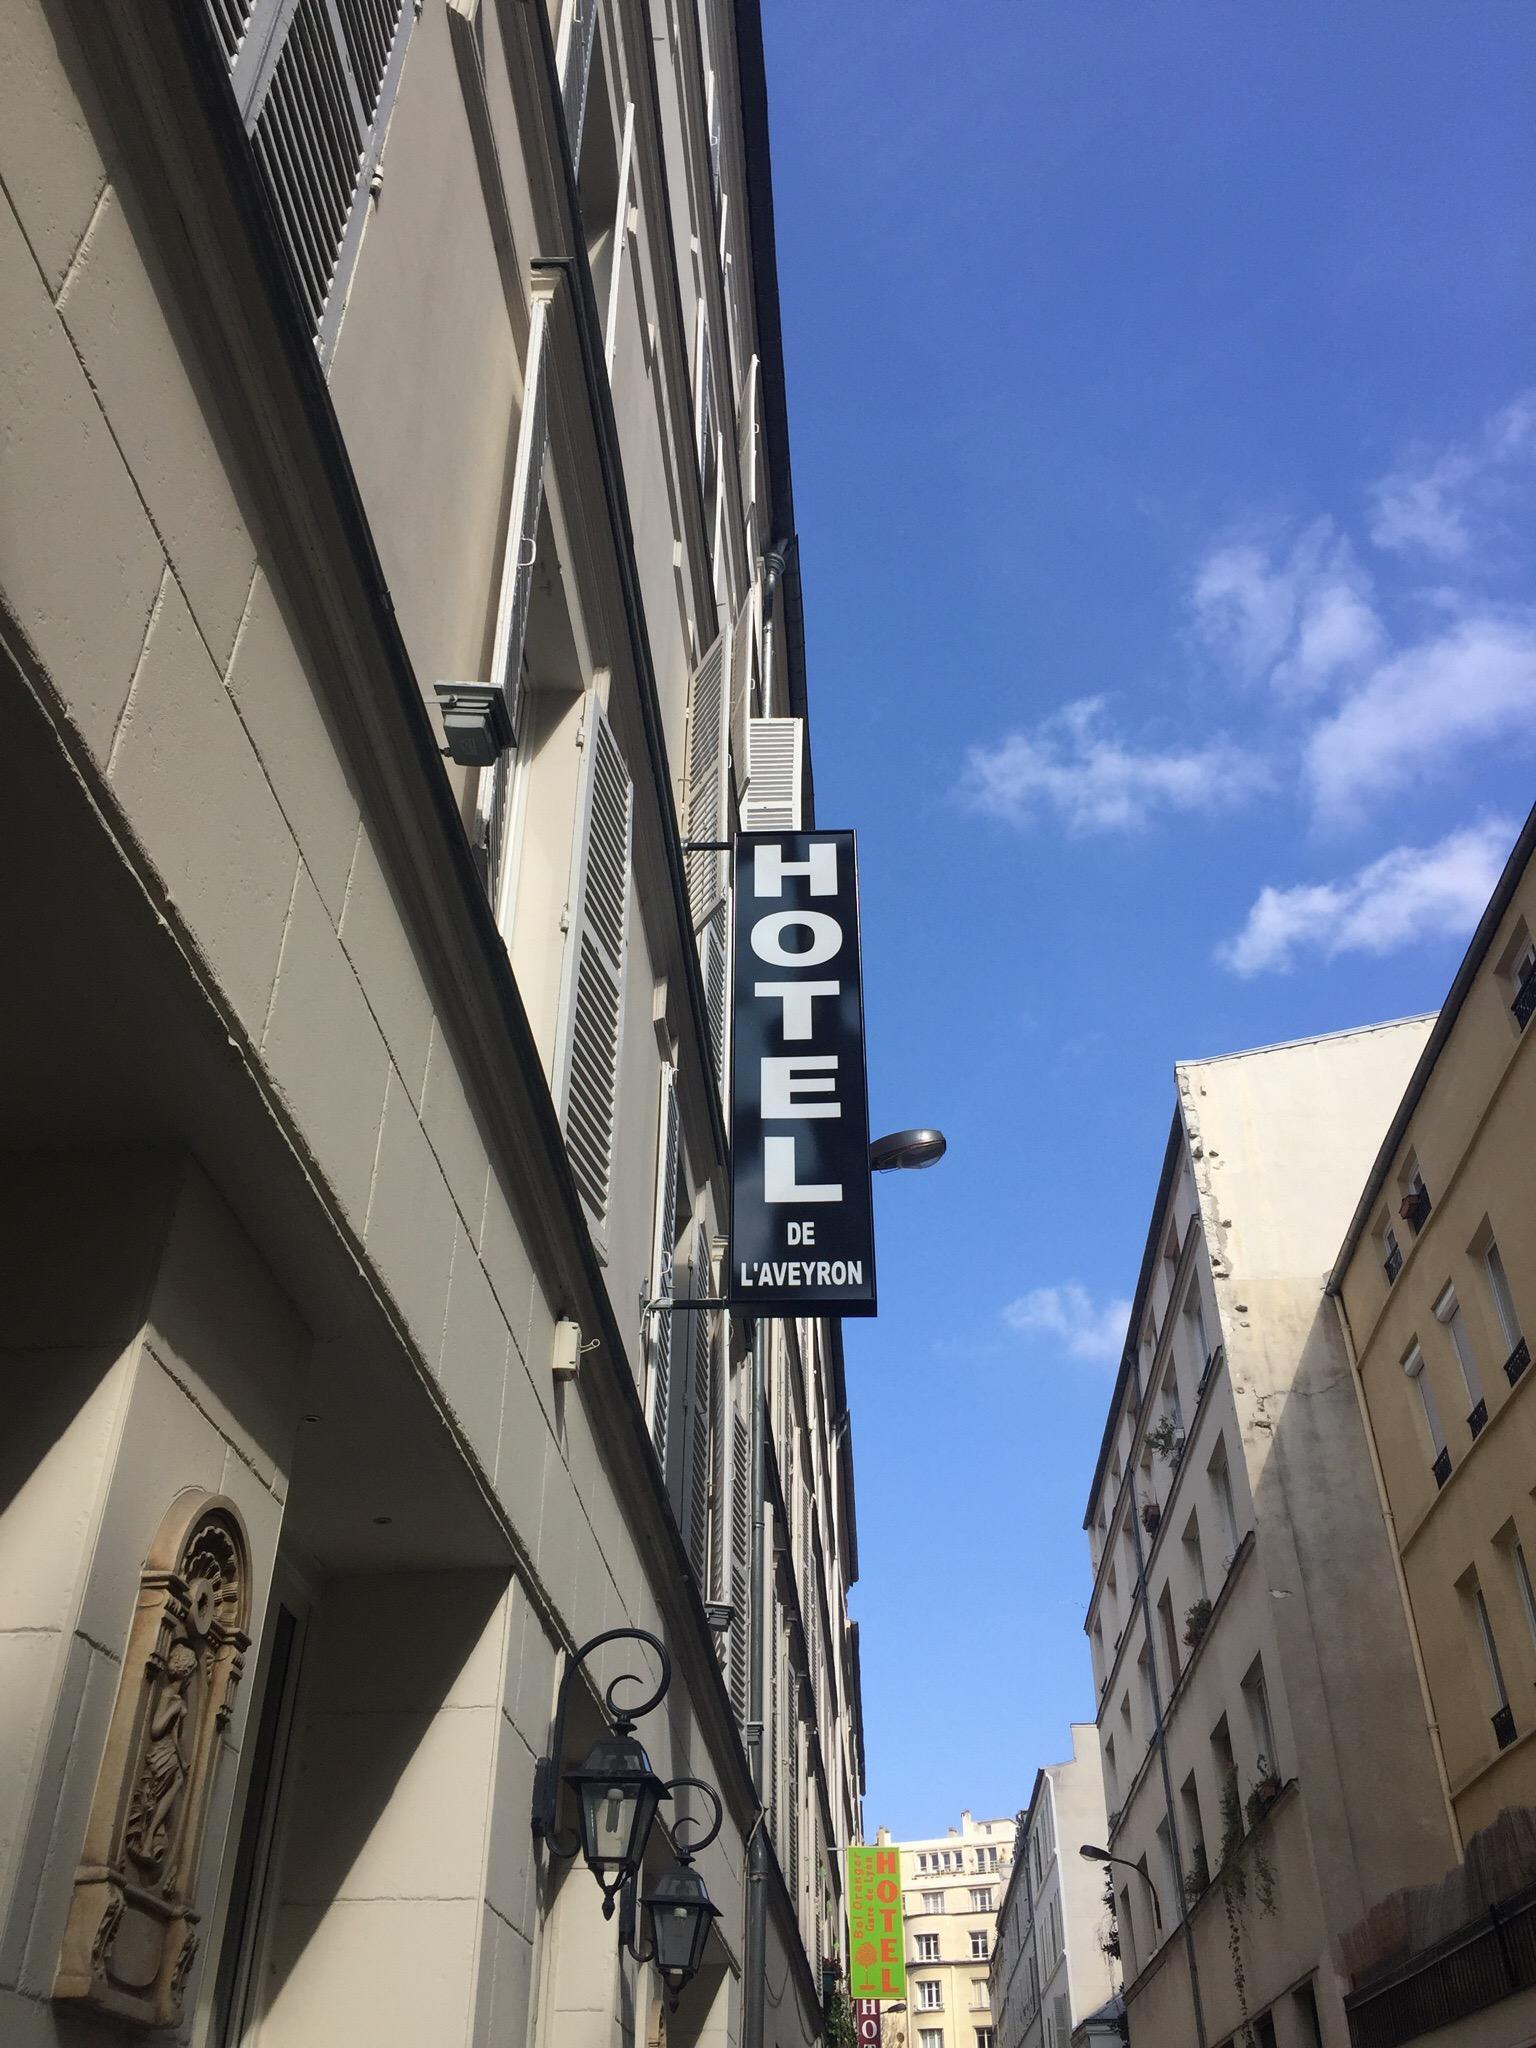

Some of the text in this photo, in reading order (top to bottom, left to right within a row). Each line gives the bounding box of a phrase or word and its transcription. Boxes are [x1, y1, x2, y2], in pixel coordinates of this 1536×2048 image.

[750, 843, 844, 1203] HOTEL
[787, 1221, 815, 1246] DE
[740, 1260, 863, 1287] L'AVEYRON
[864, 1856, 875, 1883] Lyon
[876, 1851, 899, 1993] HOTEL
[861, 1999, 878, 2048] HO
